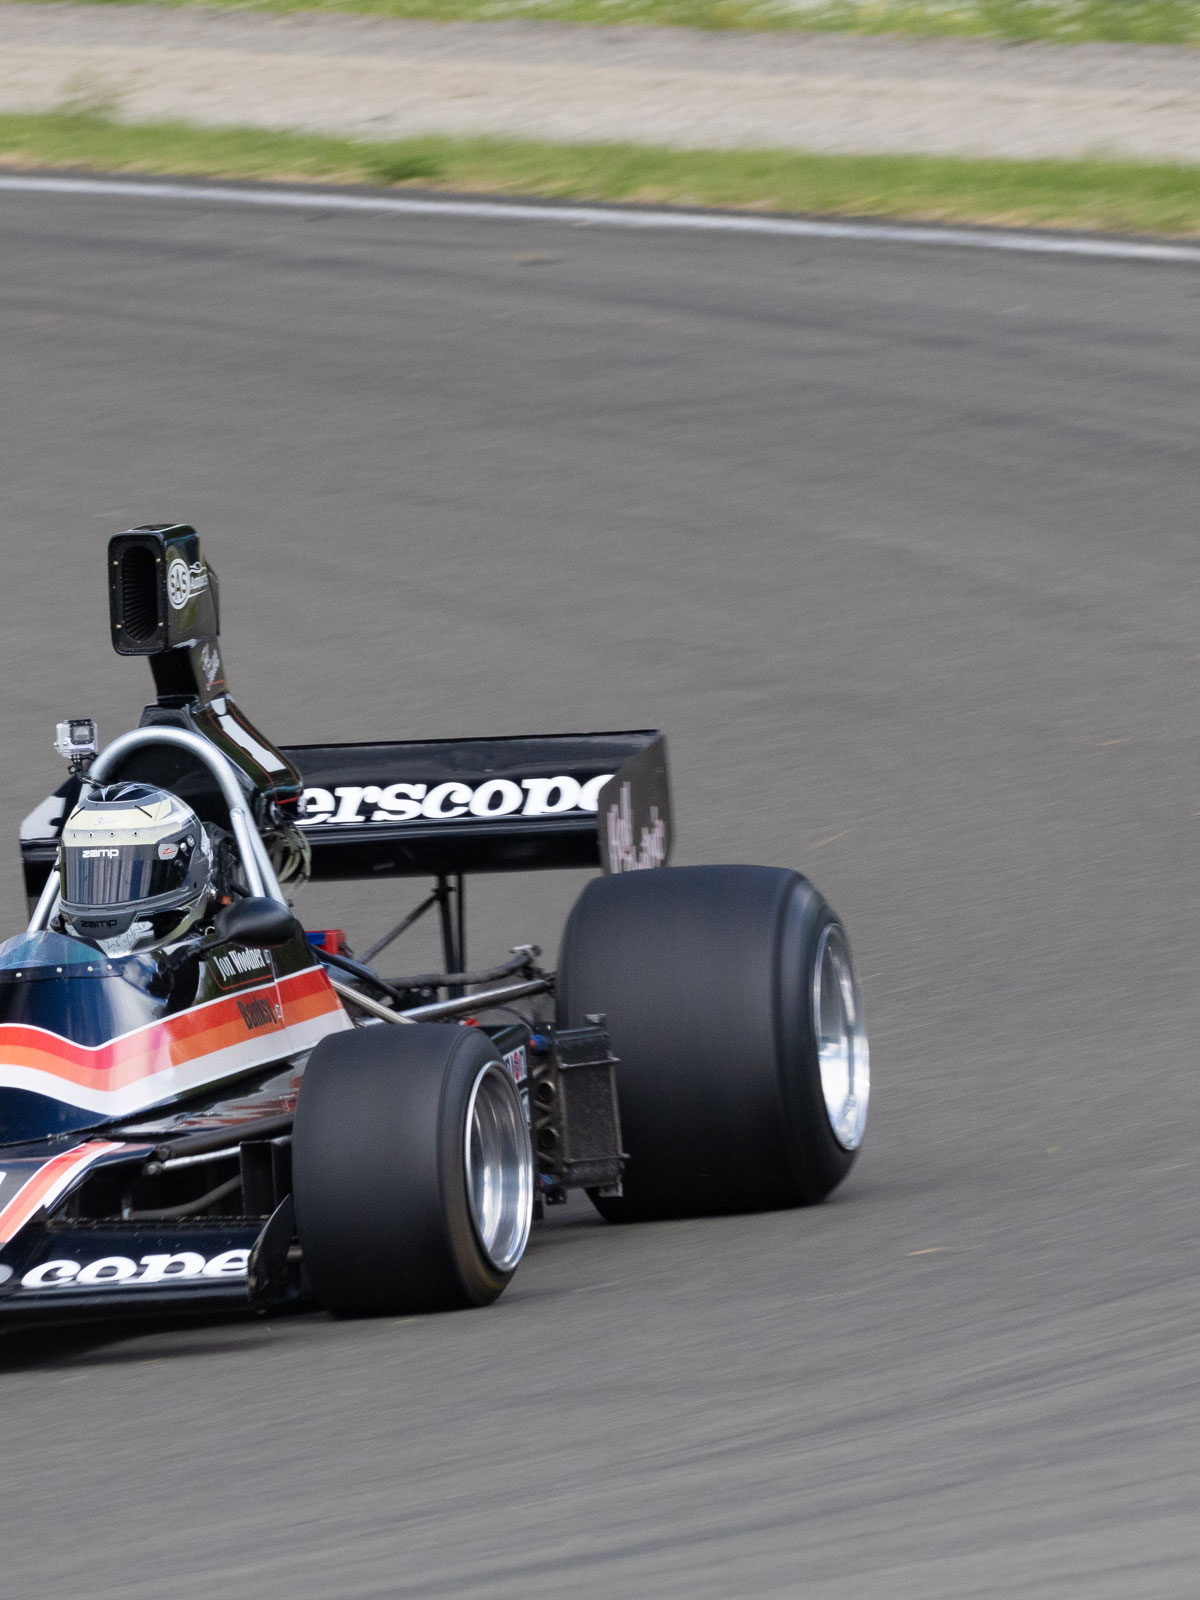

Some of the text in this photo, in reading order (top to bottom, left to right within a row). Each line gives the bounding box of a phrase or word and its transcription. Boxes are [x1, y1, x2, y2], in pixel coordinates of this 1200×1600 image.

[82, 849, 119, 858] zamp
[81, 920, 117, 928] zamp
[212, 956, 236, 981] Jon
[236, 996, 277, 1030] Banksy
